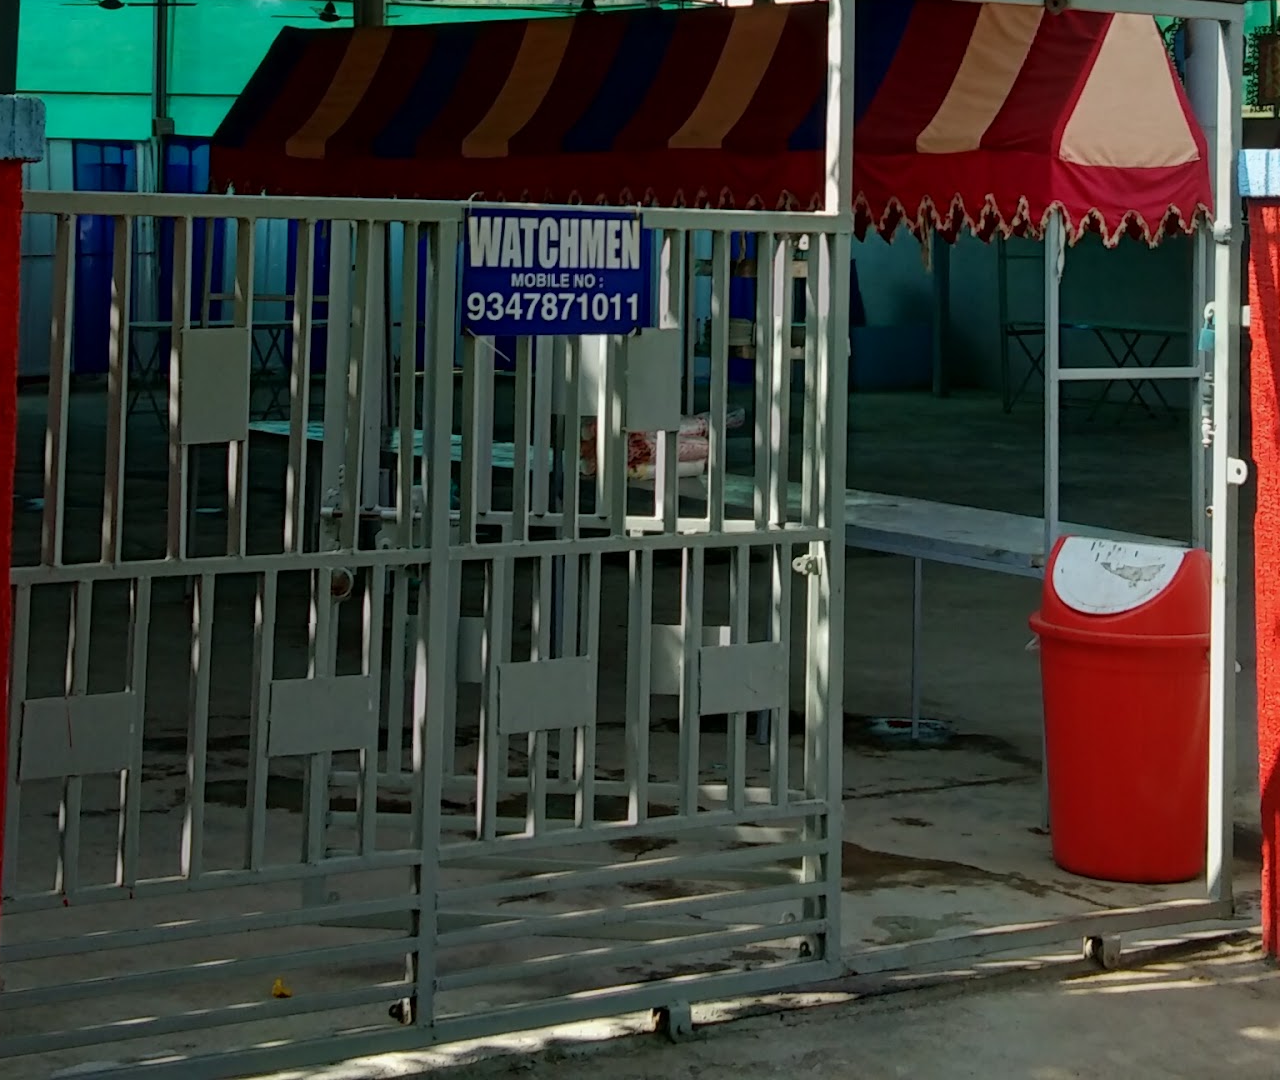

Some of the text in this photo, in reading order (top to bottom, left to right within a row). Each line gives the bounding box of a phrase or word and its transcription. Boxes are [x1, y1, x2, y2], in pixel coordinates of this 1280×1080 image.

[469, 217, 640, 269] WATCHMEN
[511, 273, 570, 288] MOBILE
[467, 292, 639, 321] 9347871011
